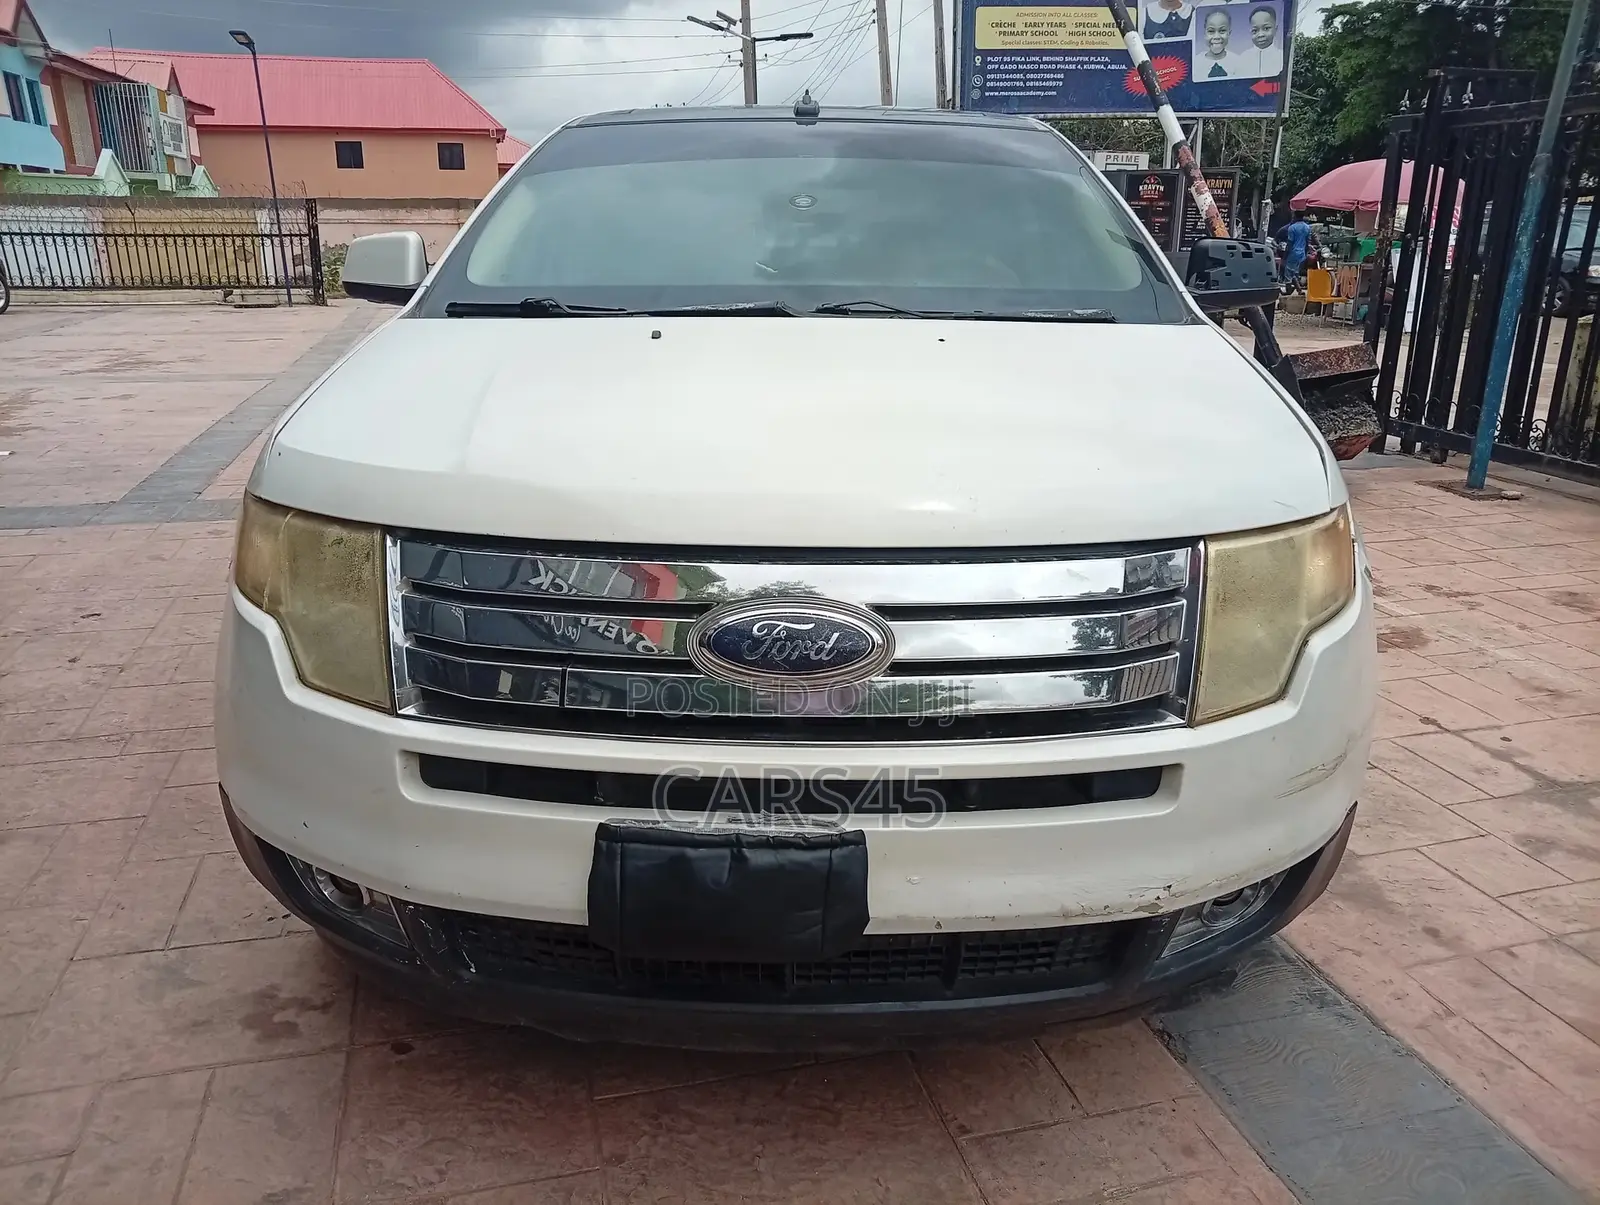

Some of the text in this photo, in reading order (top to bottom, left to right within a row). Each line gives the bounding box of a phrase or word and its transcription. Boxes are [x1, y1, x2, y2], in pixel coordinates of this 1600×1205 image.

[1105, 155, 1140, 163] PRIME
[1207, 179, 1233, 188] KRAVYN
[742, 620, 840, 660] Ford
